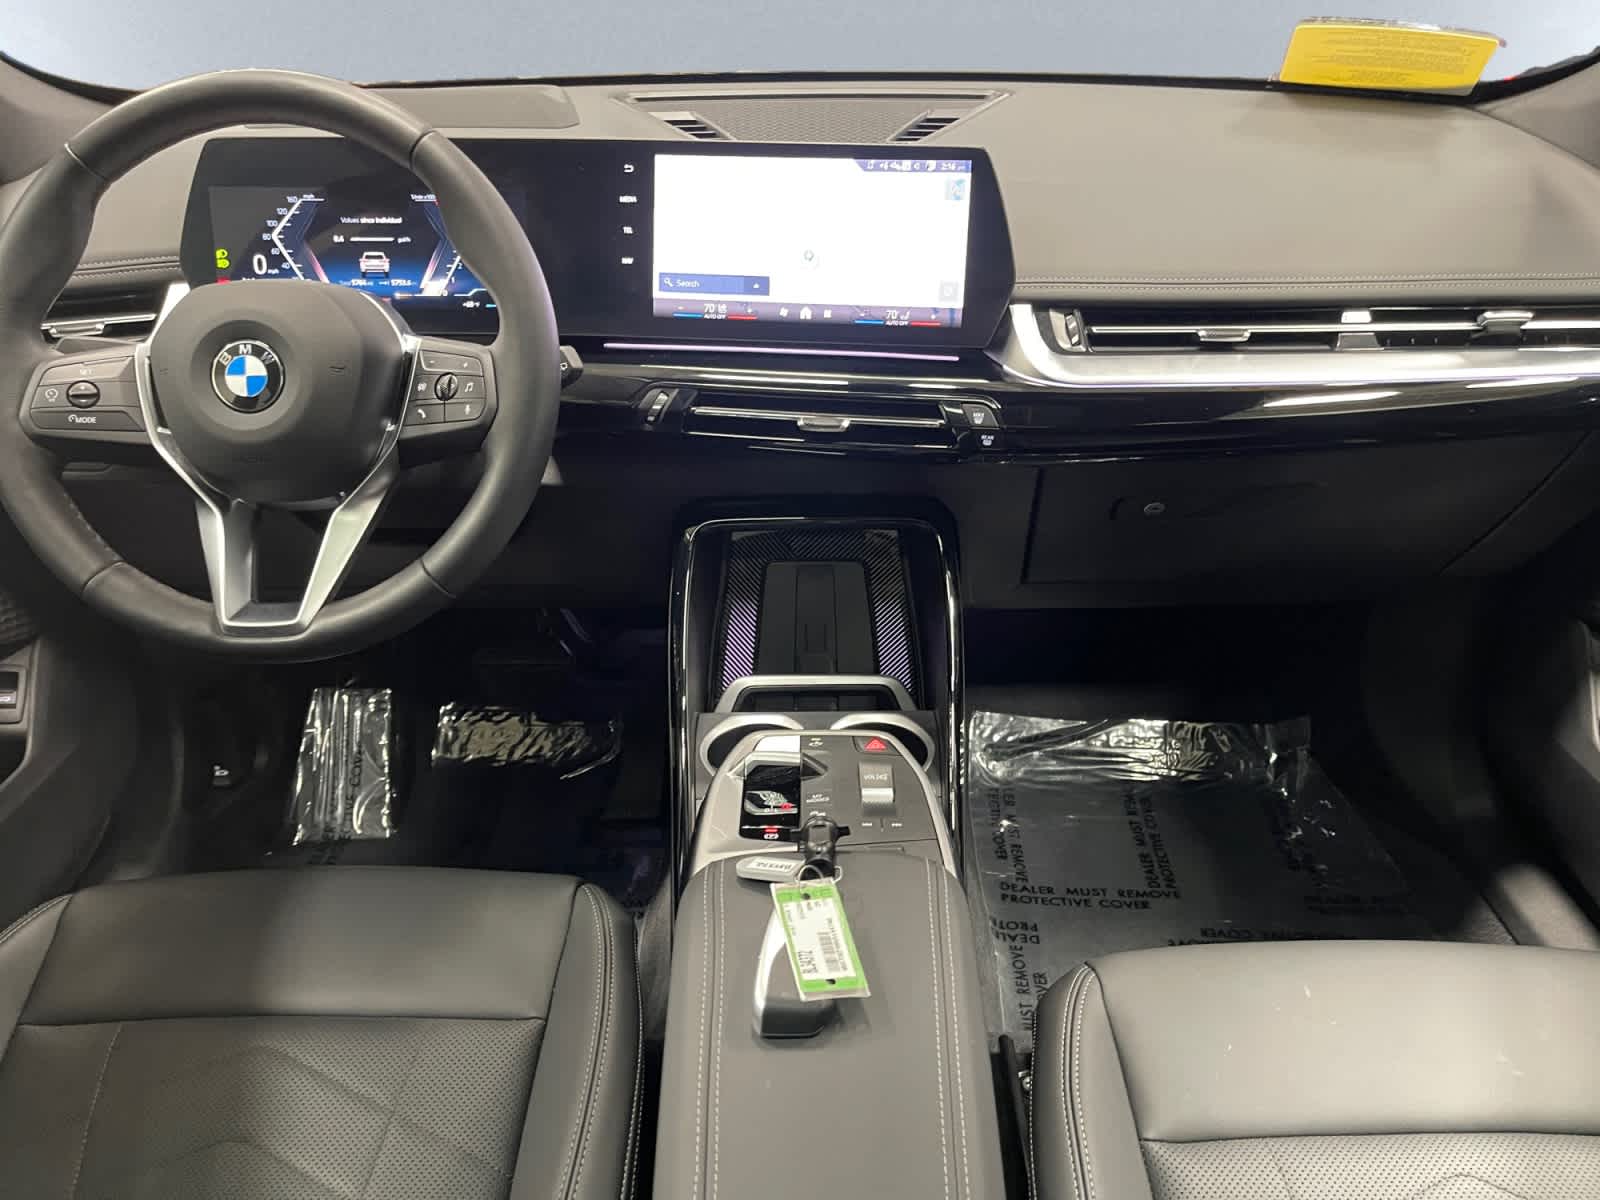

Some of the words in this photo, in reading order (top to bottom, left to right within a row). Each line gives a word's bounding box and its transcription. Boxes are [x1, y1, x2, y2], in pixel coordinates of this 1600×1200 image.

[252, 253, 268, 275] 0
[676, 279, 700, 288] Search
[219, 344, 275, 366] BMW
[75, 416, 97, 424] MODE
[1000, 881, 1056, 896] DEALER
[1066, 887, 1109, 898] MUST
[1117, 888, 1182, 900] REMOVE
[1000, 893, 1094, 908] PROTECTIVE
[1099, 899, 1152, 910] COVER
[1009, 944, 1031, 995] REMOVE
